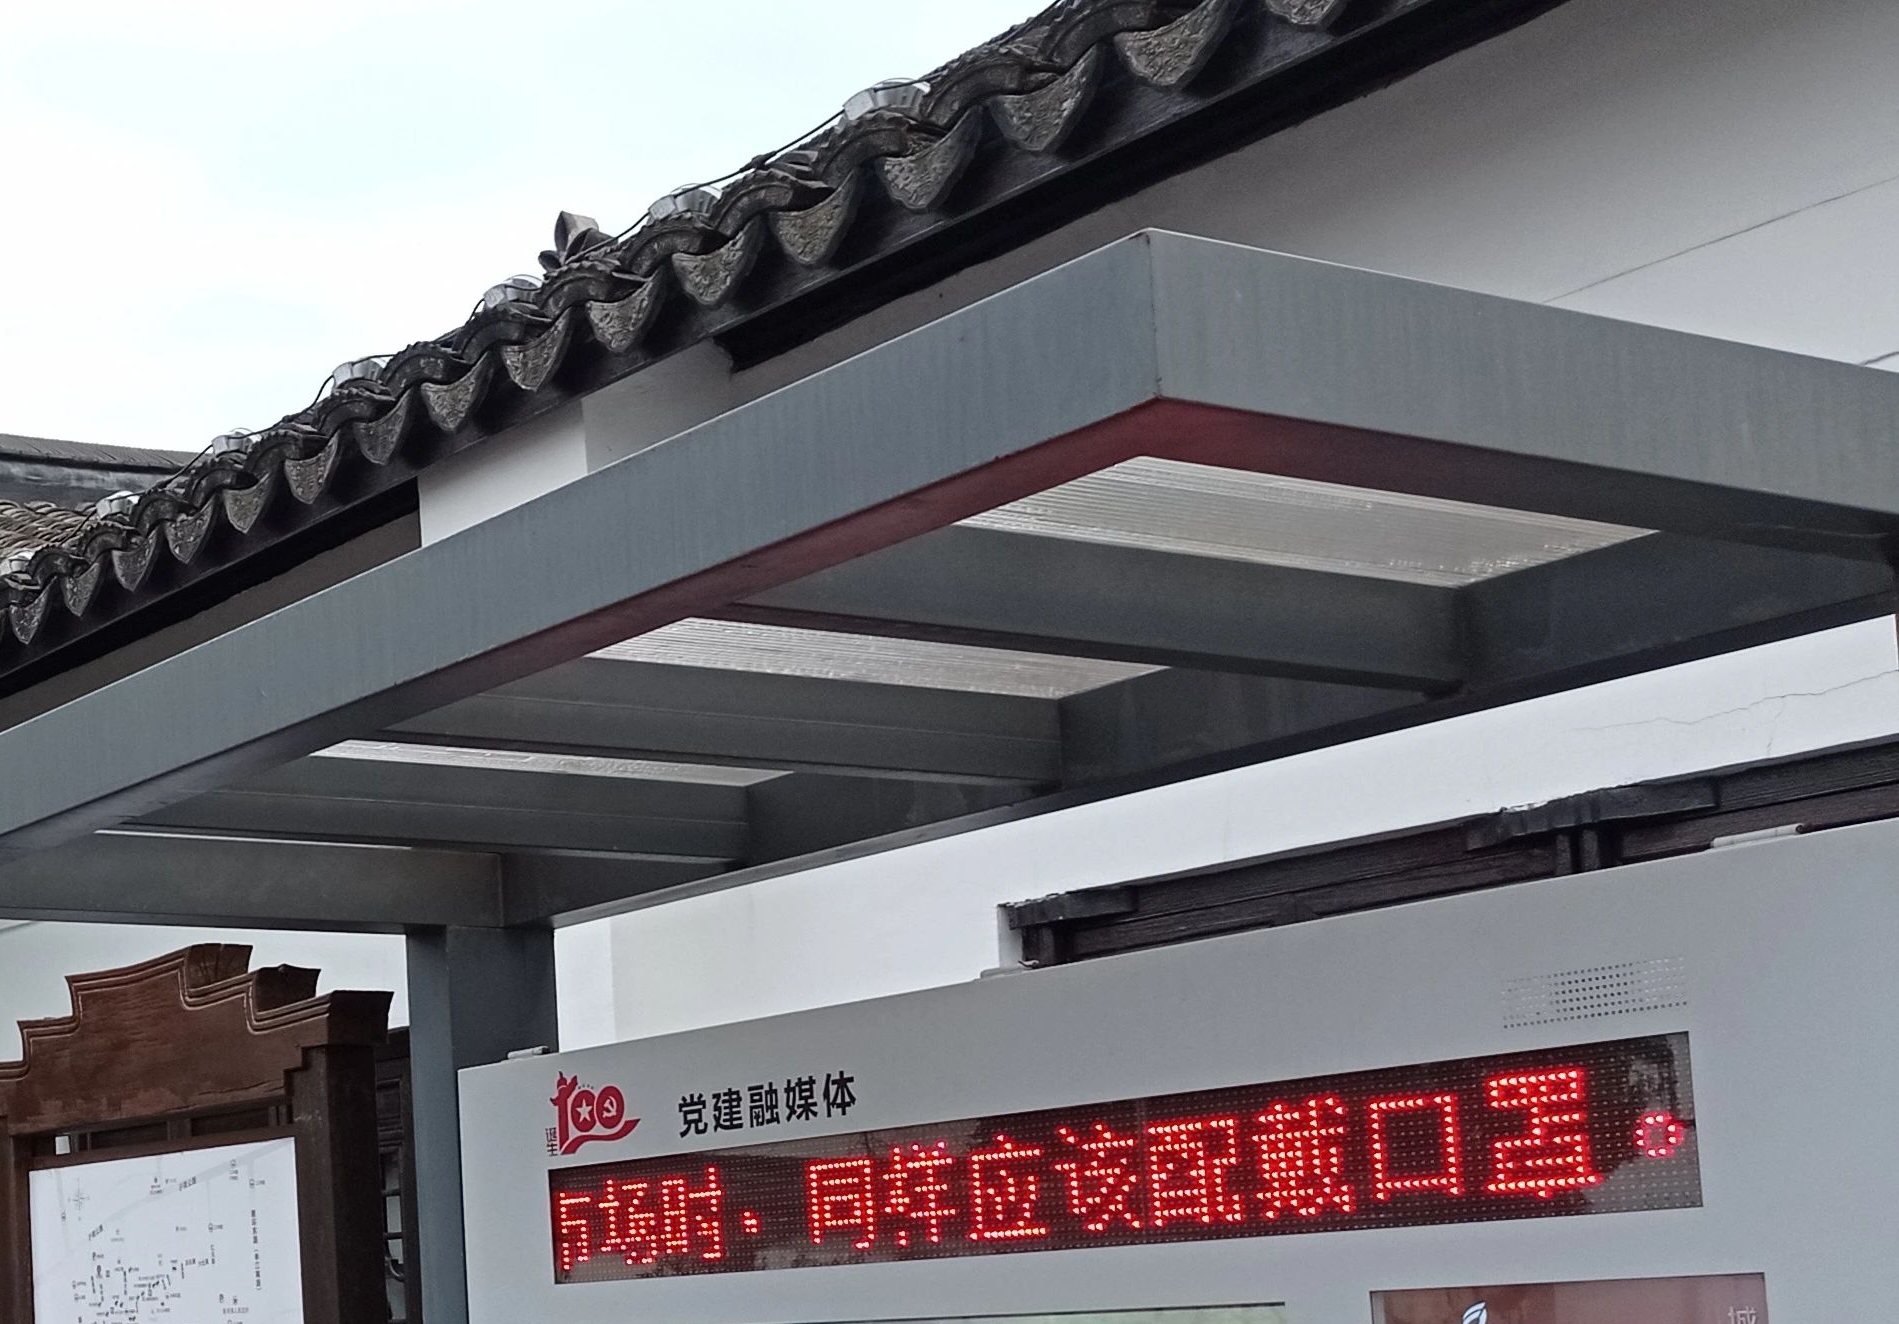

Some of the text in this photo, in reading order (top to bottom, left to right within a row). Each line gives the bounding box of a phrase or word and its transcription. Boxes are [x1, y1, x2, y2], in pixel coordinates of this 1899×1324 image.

[677, 1069, 858, 1138] 党建融媒体
